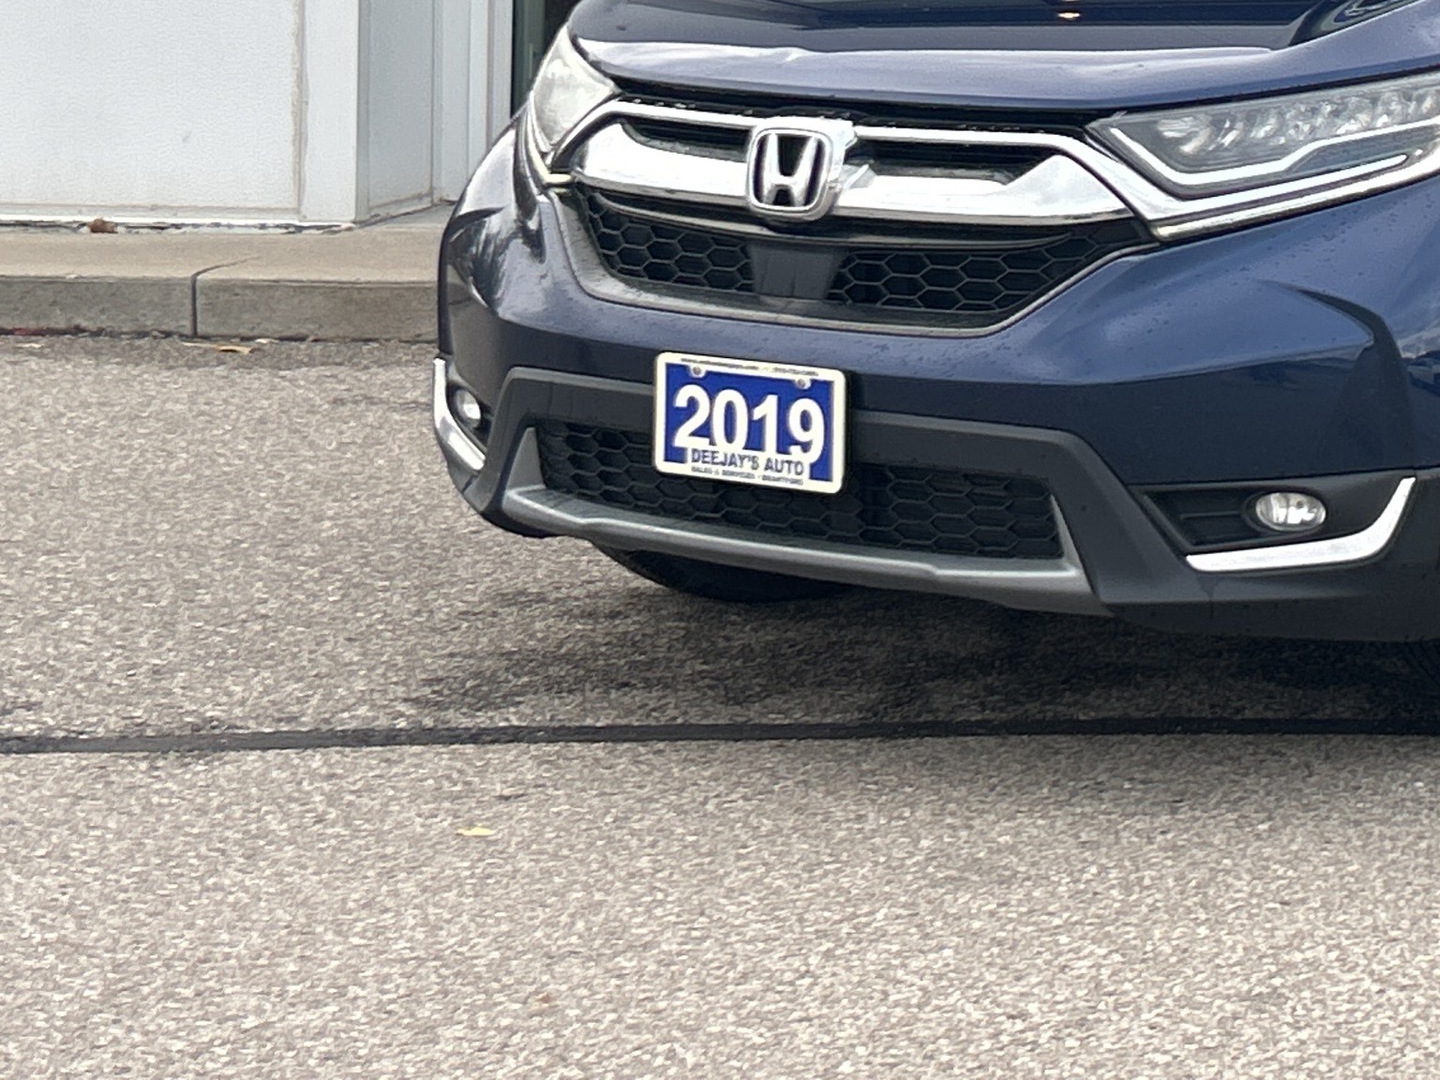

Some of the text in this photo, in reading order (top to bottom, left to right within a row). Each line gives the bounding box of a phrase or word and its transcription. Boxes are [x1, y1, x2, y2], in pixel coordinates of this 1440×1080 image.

[674, 384, 825, 464] 2019
[691, 448, 804, 476] DEEJAY'S AUTO
